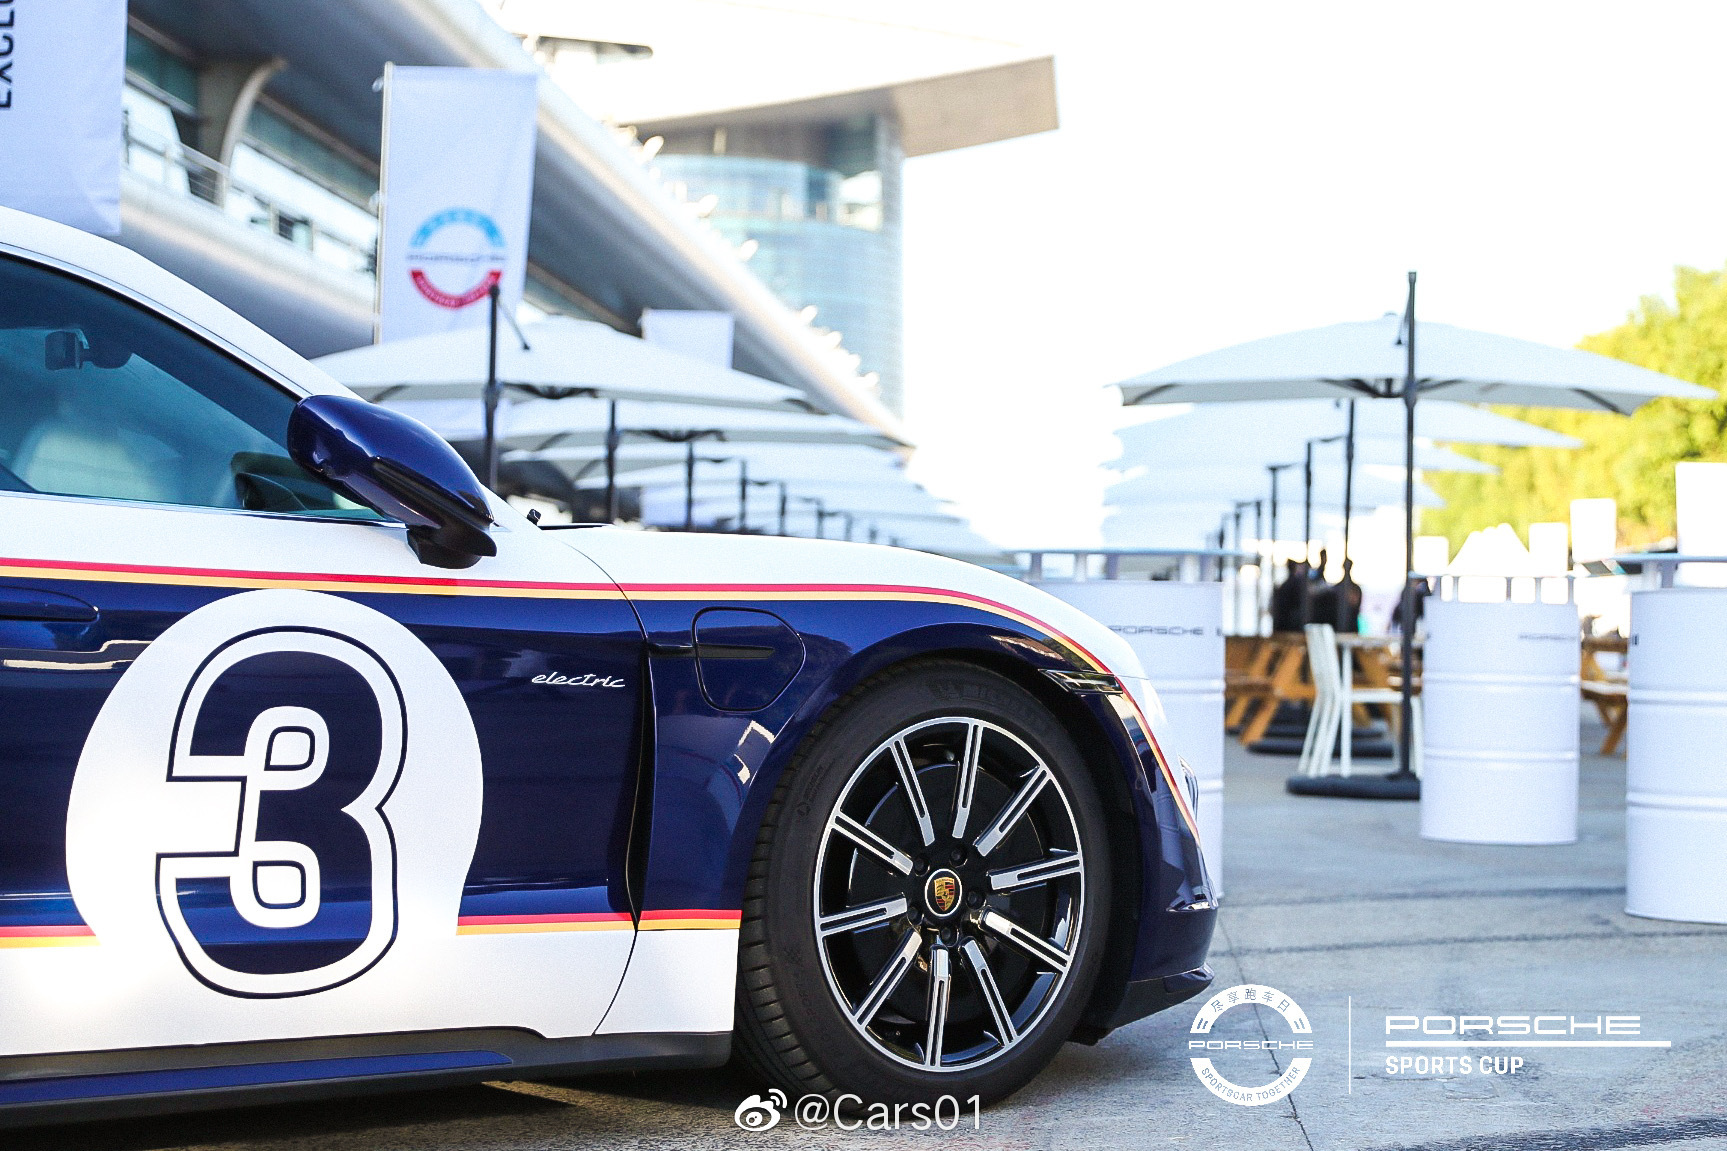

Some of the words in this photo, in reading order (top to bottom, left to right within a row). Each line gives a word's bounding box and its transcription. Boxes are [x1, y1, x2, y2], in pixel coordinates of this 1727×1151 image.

[0, 0, 15, 109] EXCL
[531, 671, 626, 688] electric
[155, 625, 408, 999] 3
